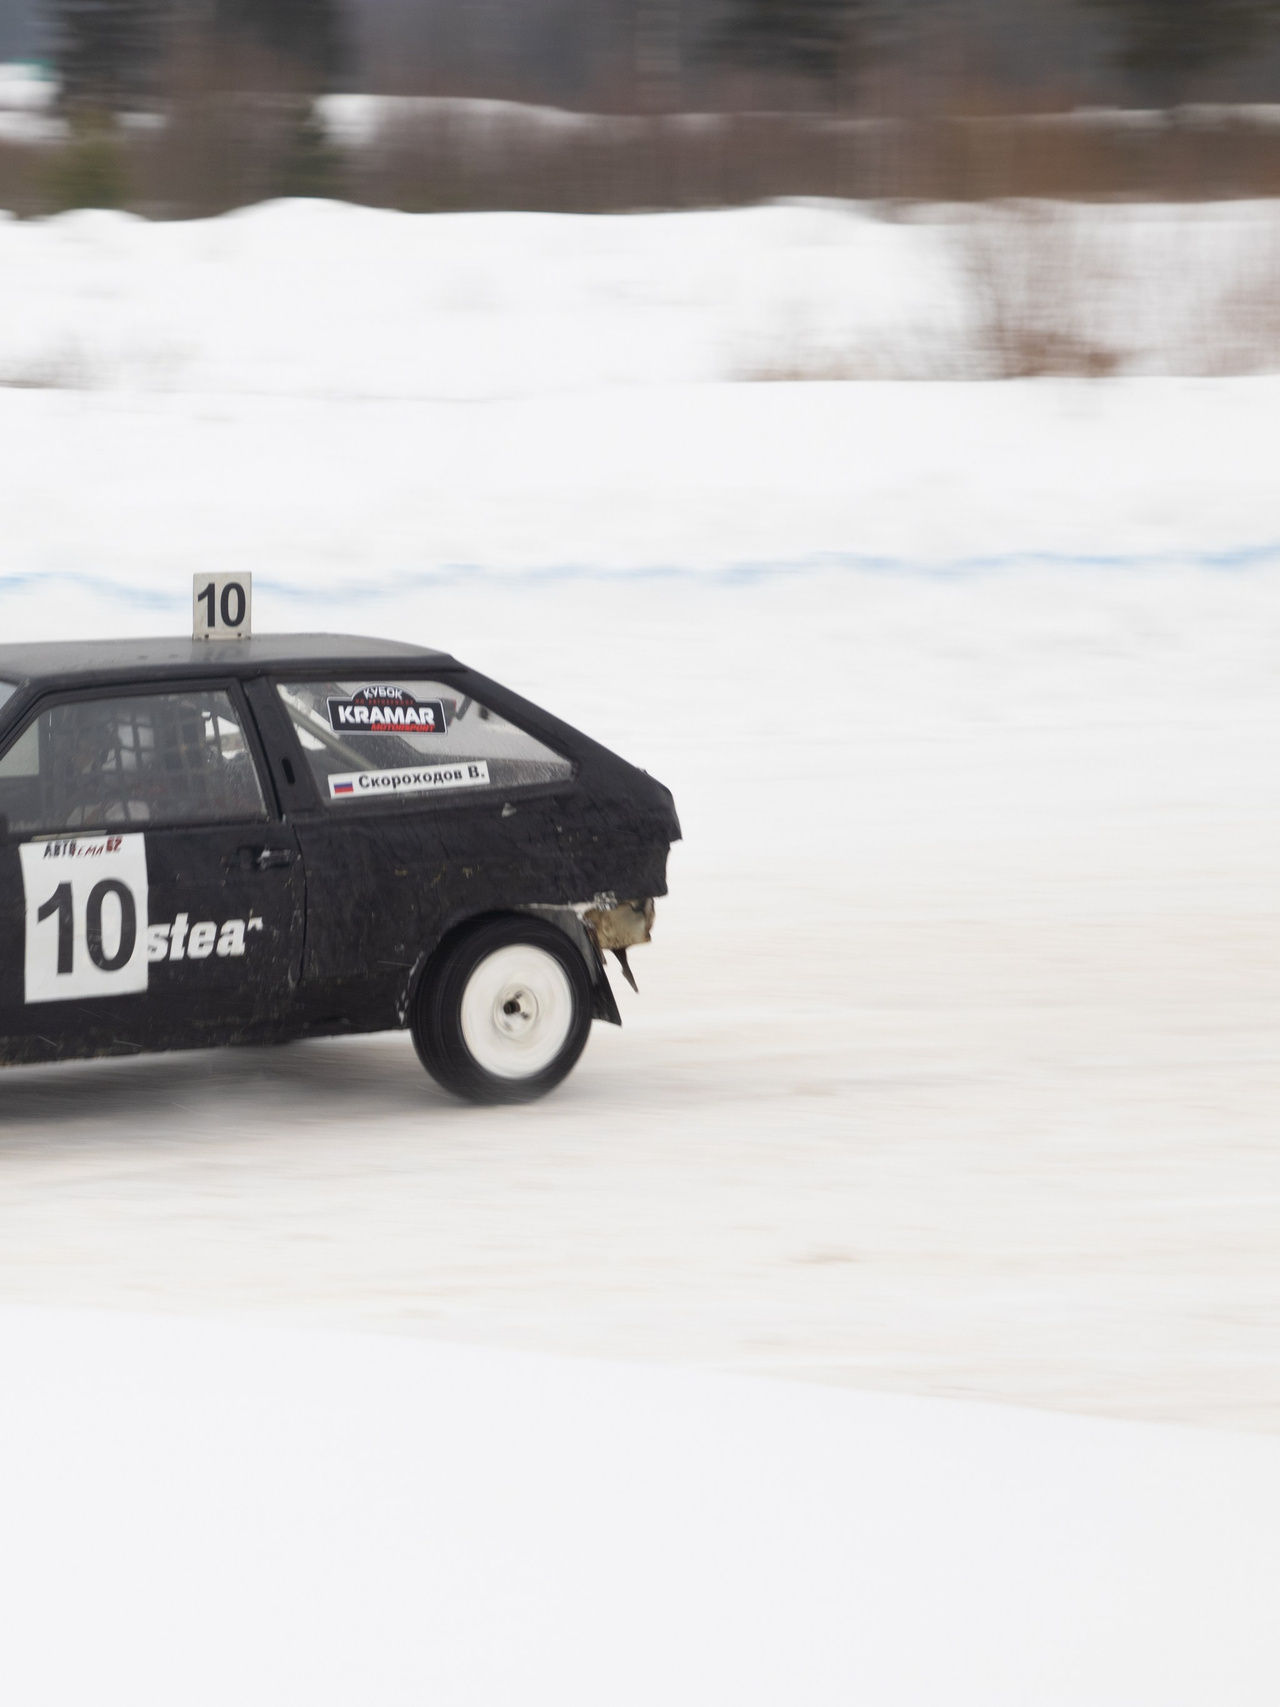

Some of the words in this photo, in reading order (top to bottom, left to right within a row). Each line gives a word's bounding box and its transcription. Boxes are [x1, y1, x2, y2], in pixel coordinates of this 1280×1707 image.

[197, 582, 246, 628] 10
[363, 686, 404, 700] КУБОК
[338, 705, 435, 725] KRAMAR
[358, 770, 463, 788] Скороходов
[467, 765, 485, 779] В.
[37, 877, 137, 976] 10
